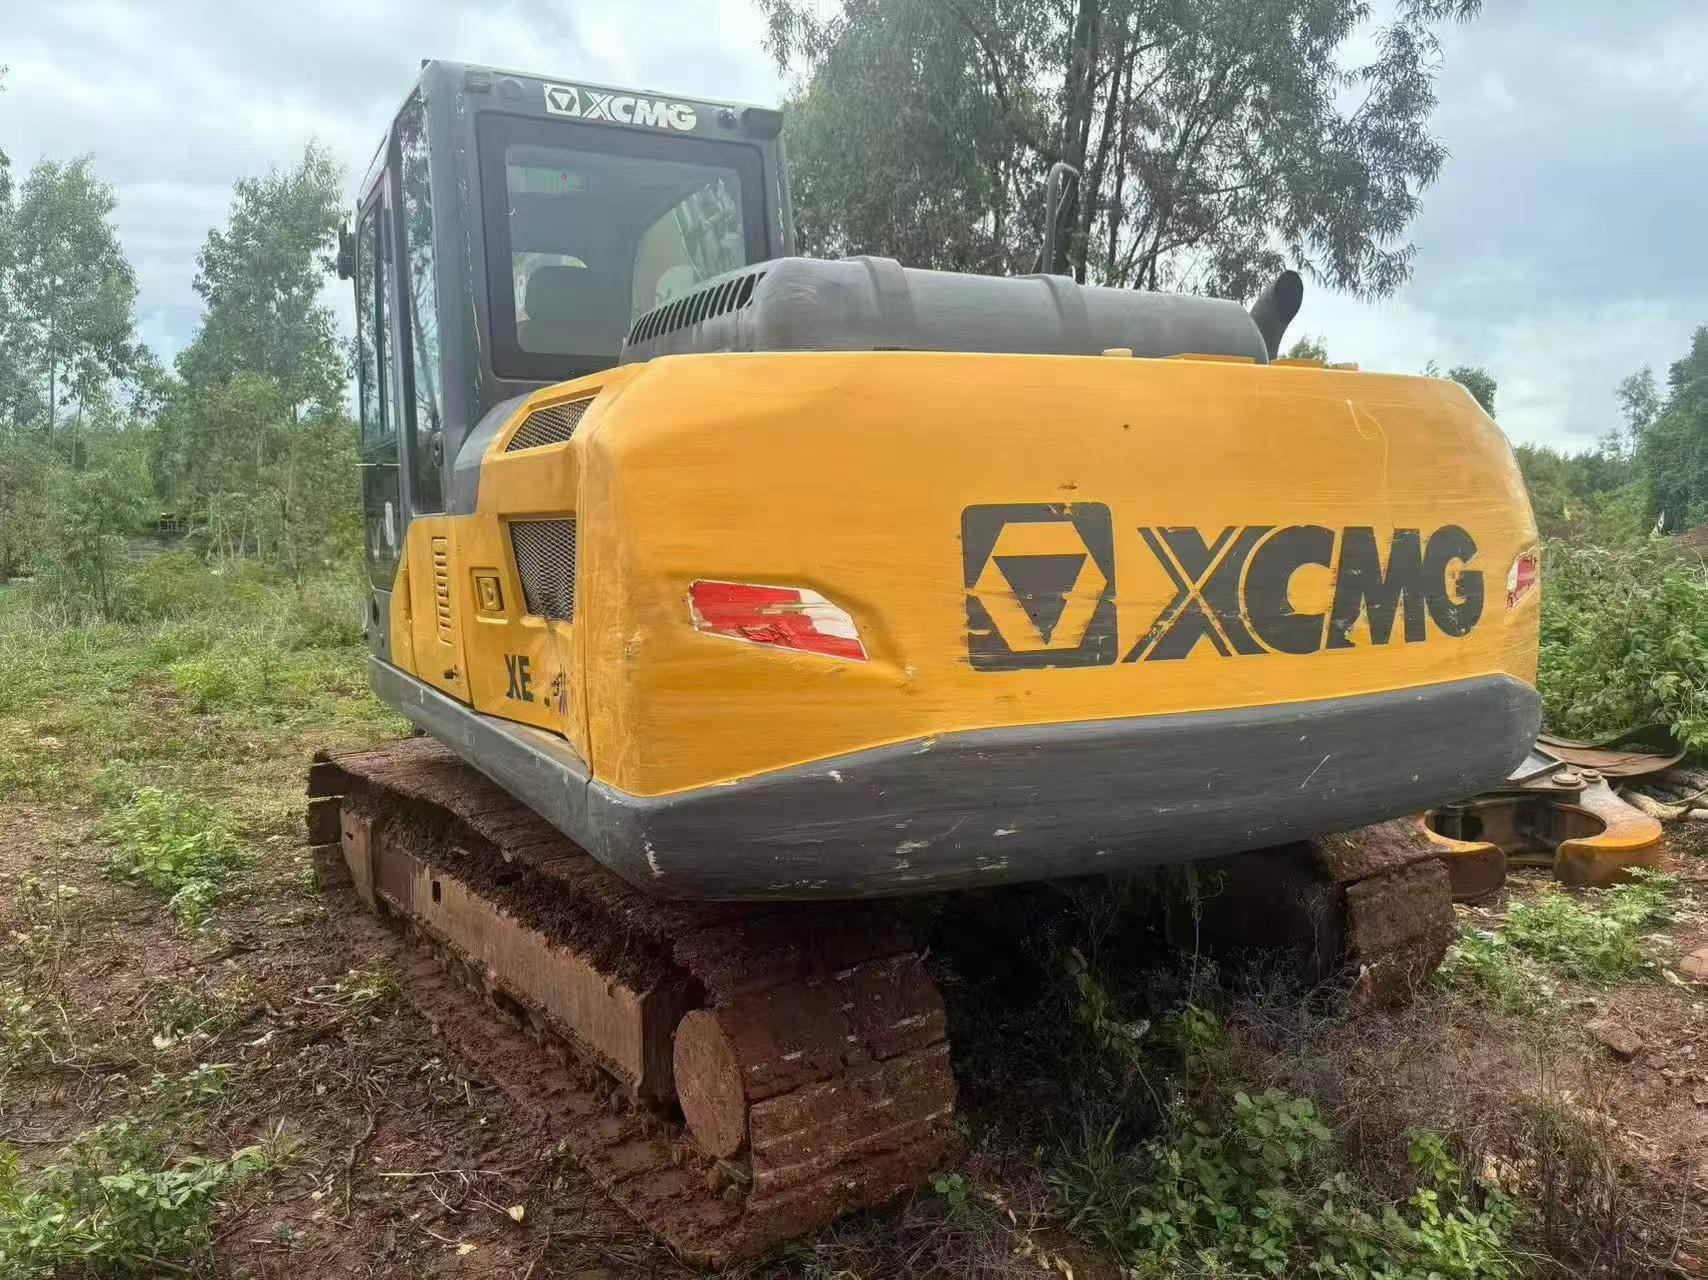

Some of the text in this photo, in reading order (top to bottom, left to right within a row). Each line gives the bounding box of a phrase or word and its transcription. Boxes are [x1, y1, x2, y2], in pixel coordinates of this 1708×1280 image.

[582, 91, 697, 131] XCMG
[1121, 524, 1485, 663] XCMG
[504, 653, 534, 702] XE
